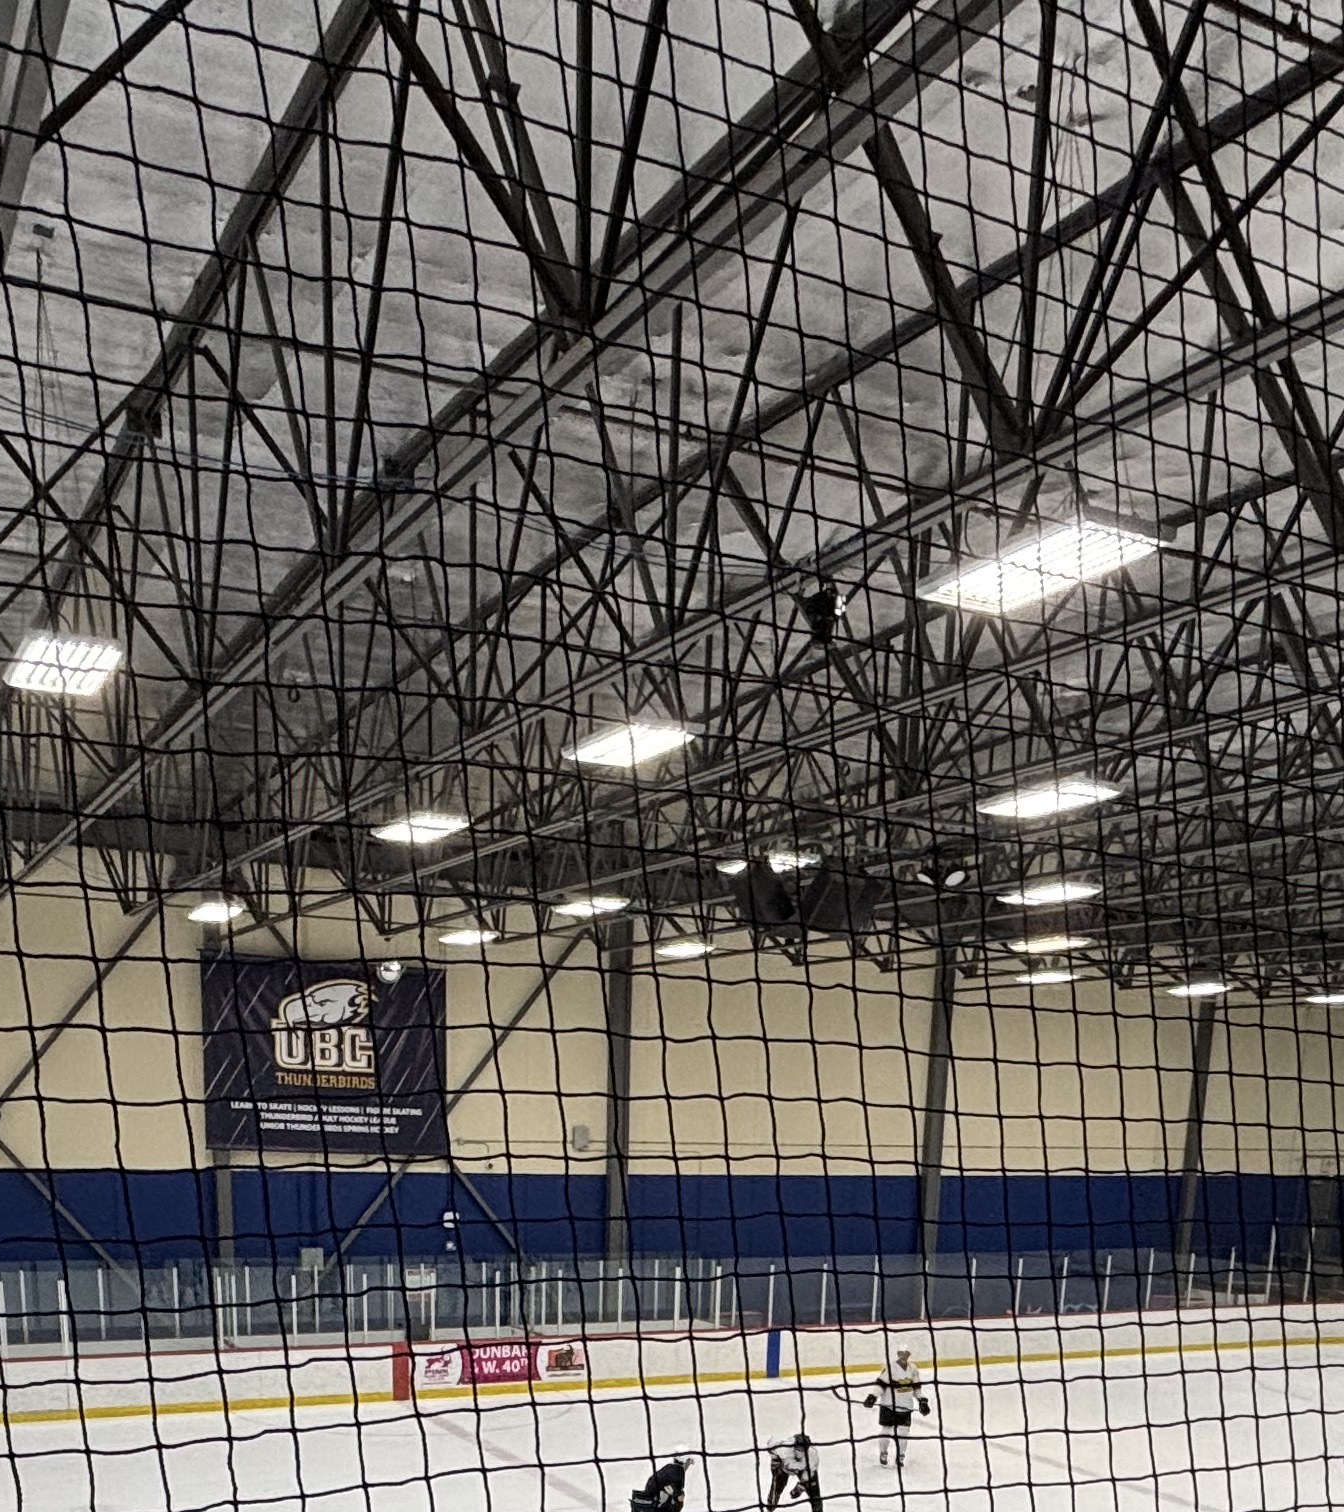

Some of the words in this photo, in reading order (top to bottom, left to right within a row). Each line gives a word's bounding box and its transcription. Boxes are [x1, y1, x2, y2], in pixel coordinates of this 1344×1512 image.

[271, 1018, 375, 1073] UBC
[256, 1102, 268, 1111] TO
[297, 1104, 328, 1113] HOCKY
[314, 1113, 338, 1122] AULT
